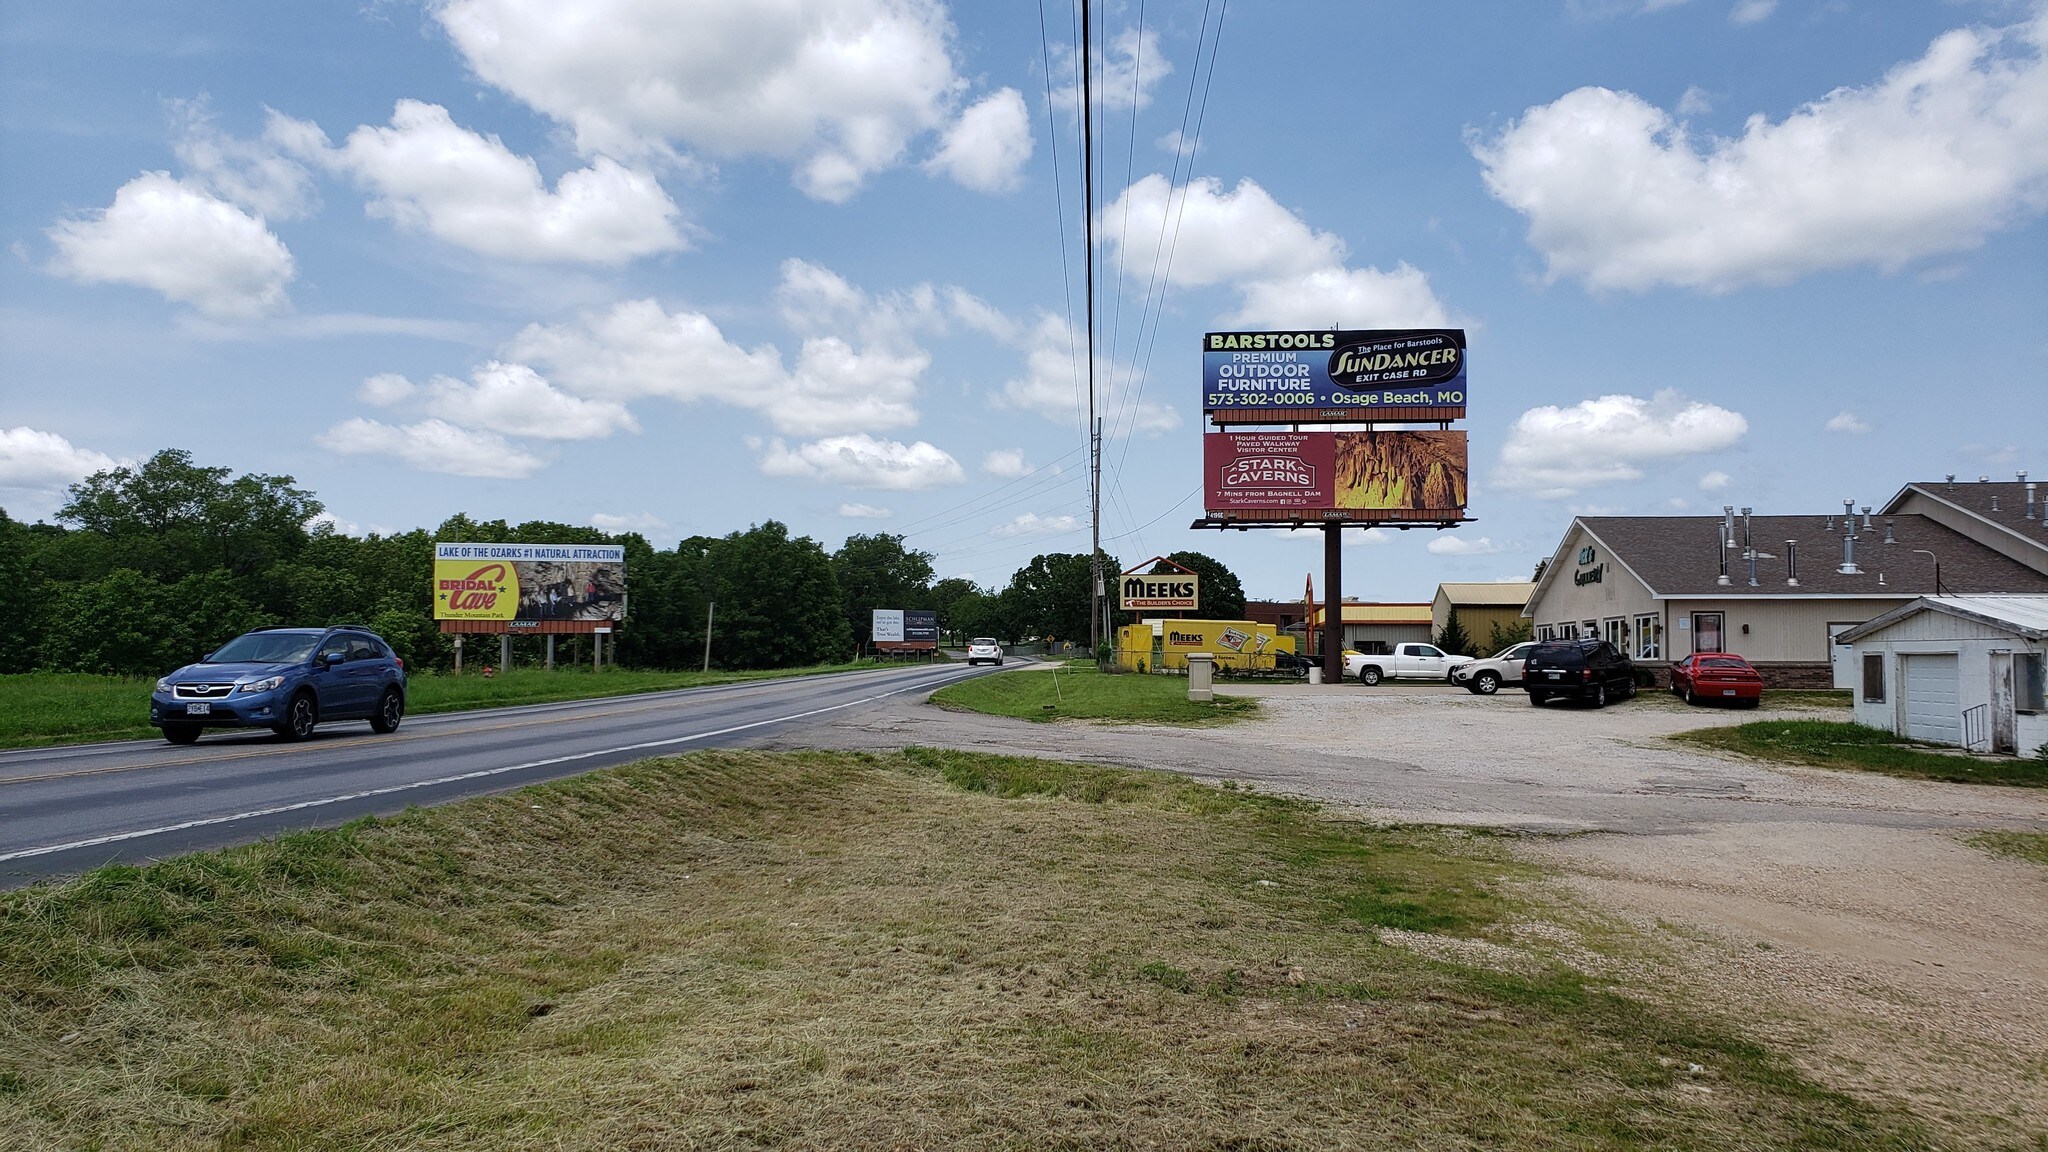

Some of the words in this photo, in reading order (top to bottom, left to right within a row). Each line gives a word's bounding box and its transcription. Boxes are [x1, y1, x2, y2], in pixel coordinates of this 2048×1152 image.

[1210, 334, 1335, 348] BARSTOOLS
[1358, 346, 1371, 354] The
[1373, 343, 1392, 351] Place
[1393, 341, 1405, 349] for
[1407, 337, 1443, 348] Barstools
[1233, 353, 1297, 363] PREMIUM
[1331, 347, 1457, 376] SUNDANCER
[1219, 364, 1310, 378] OUTDOOR
[1356, 373, 1379, 383] EXIT
[1382, 371, 1410, 381] CASE
[1412, 369, 1427, 378] RD
[1218, 379, 1311, 390] FURNITURE
[1208, 393, 1315, 405] 573-302-0006
[1331, 393, 1379, 405] Osage
[1384, 392, 1433, 406] Beach,
[1438, 392, 1464, 403] MO
[1237, 459, 1296, 471] STARK
[1227, 471, 1310, 485] CAVERNS
[439, 547, 460, 557] LAKE
[461, 547, 472, 557] OF
[474, 548, 489, 557] THE
[490, 548, 522, 558] OZARKS
[523, 549, 533, 558] #1
[535, 549, 571, 558] NATURAL
[572, 549, 621, 559] ATTRACTION
[439, 580, 496, 590] BRIDAL
[449, 564, 505, 610] Cave
